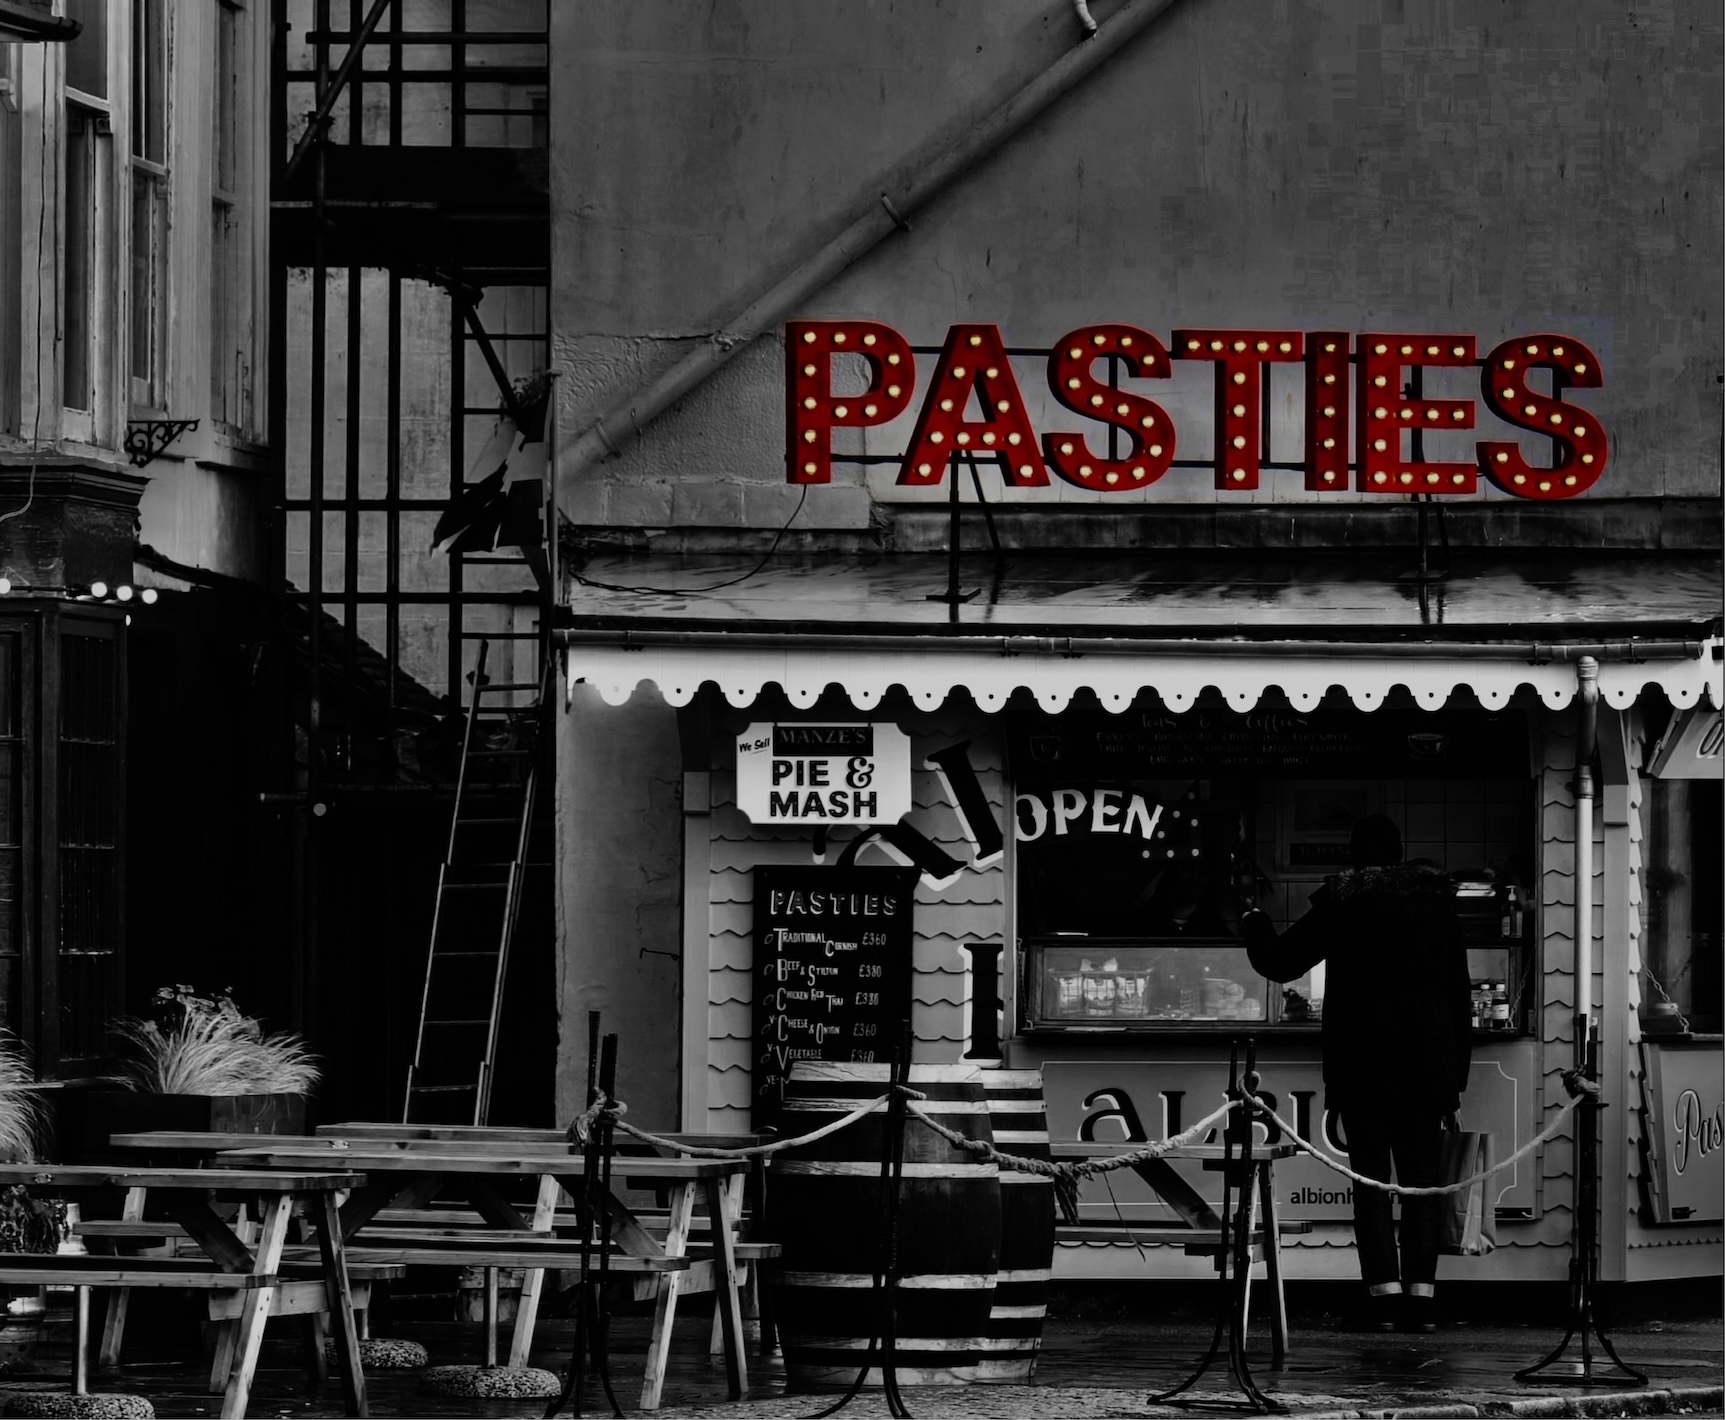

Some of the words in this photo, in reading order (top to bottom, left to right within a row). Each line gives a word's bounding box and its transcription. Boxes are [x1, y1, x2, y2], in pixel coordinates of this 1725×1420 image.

[786, 321, 1606, 500] PASTIES
[739, 743, 752, 752] We
[754, 737, 770, 750] Sell
[779, 728, 867, 744] MANZE'S
[772, 760, 830, 786] PIE
[846, 757, 875, 789] &
[770, 791, 877, 818] MASH
[1015, 788, 1165, 841] OPEN
[769, 889, 898, 916] PASTIES
[777, 958, 800, 981] BEEF
